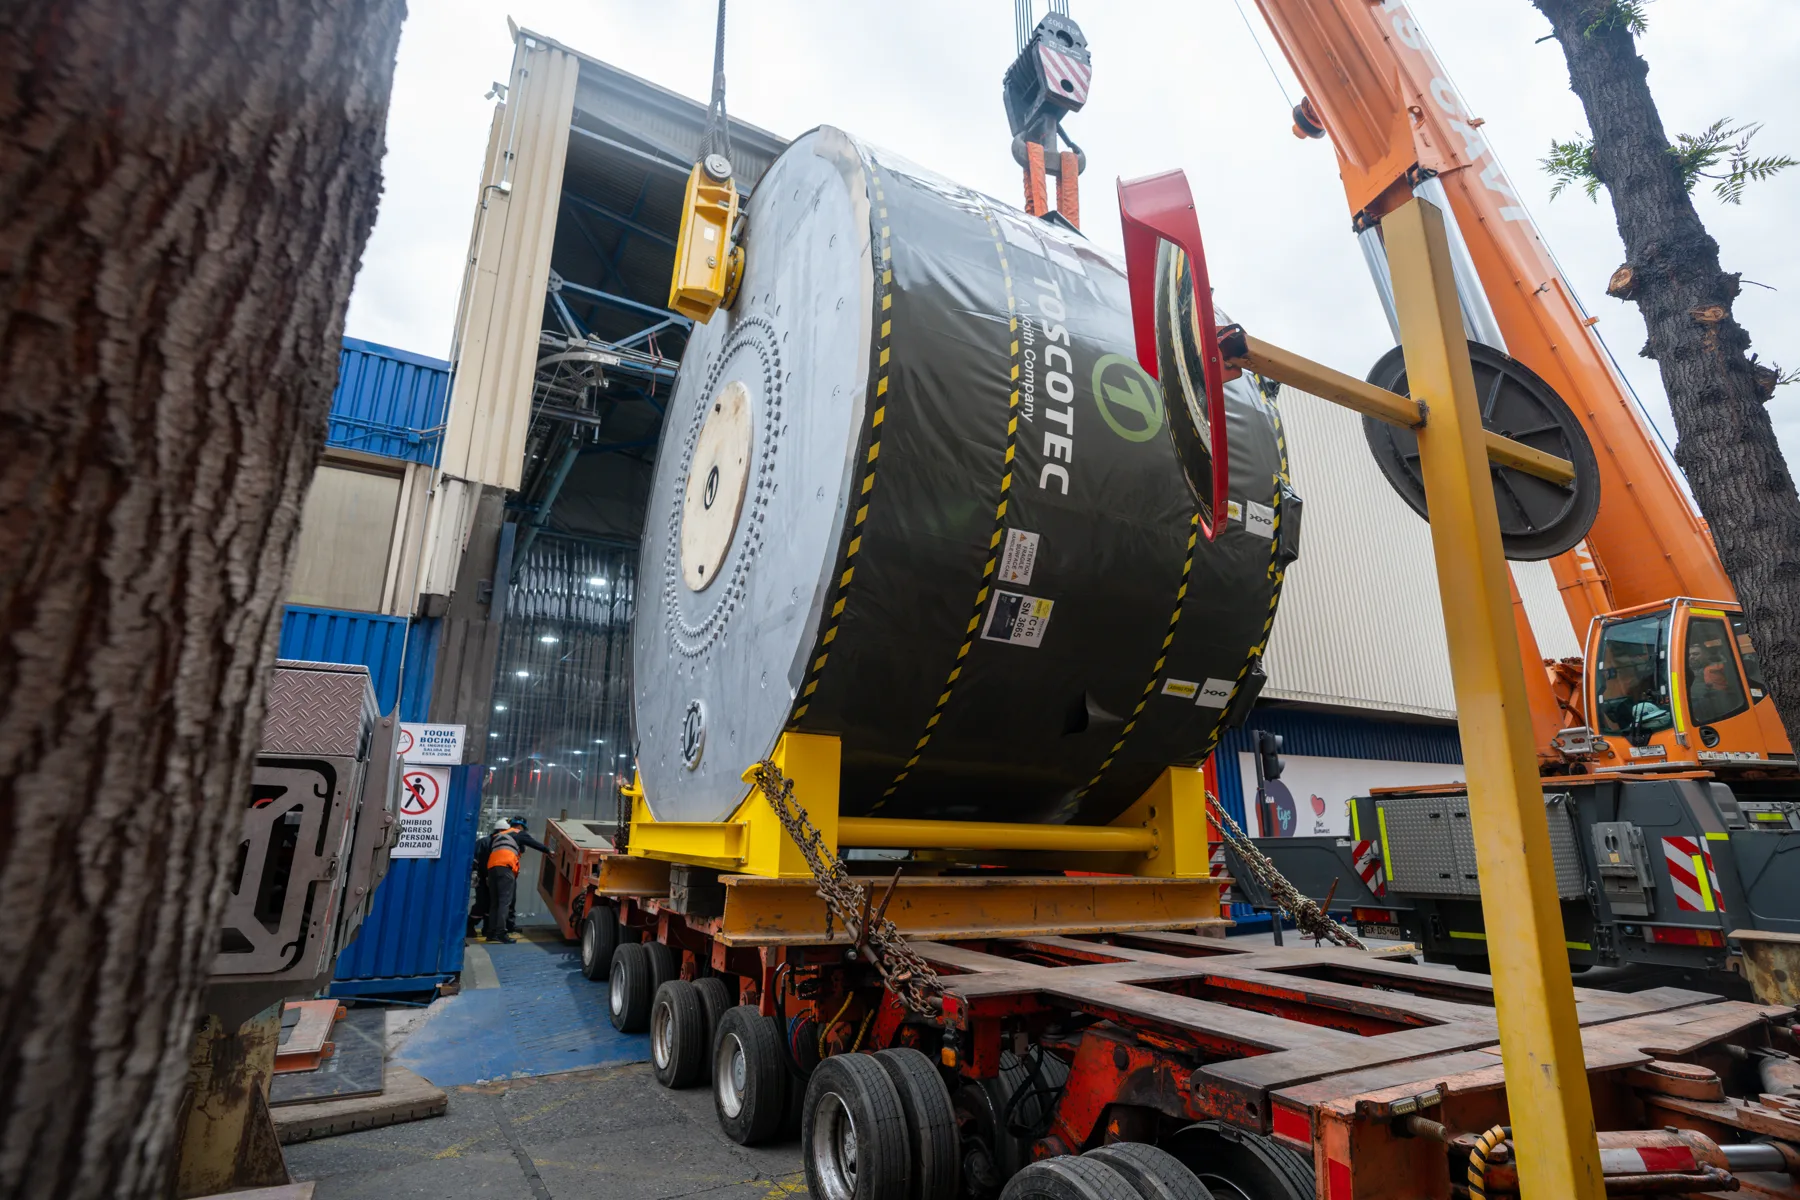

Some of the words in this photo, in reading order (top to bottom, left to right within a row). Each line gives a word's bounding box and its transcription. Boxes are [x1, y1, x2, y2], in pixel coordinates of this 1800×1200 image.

[1429, 77, 1532, 222] CAVI
[1020, 298, 1031, 307] A
[1021, 313, 1036, 345] Voith
[1021, 349, 1037, 423] Company
[1033, 277, 1075, 495] TOSCOTEC
[1012, 543, 1021, 570] SURFACE
[1019, 545, 1028, 570] FRAGILE
[1023, 542, 1035, 577] ATTENTION
[1021, 601, 1031, 616] SN
[1013, 617, 1027, 638] 3665
